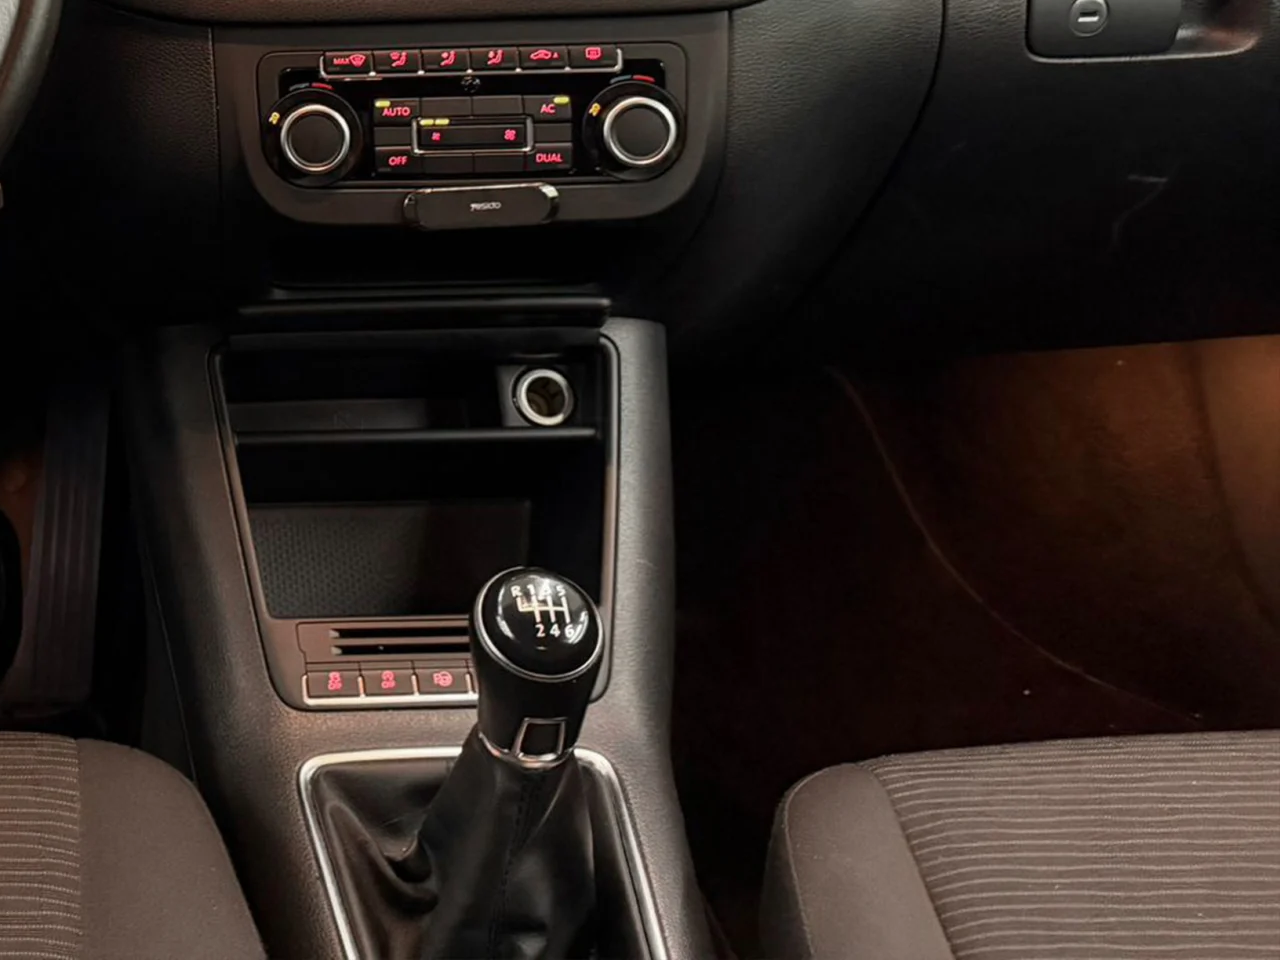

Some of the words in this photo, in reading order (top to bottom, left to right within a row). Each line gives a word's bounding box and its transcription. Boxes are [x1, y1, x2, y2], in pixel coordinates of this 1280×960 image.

[333, 56, 349, 65] MAX
[382, 106, 410, 117] AUTO
[540, 103, 556, 114] AC
[389, 155, 407, 166] OFF
[535, 152, 563, 163] DUAL
[510, 585, 522, 597] R
[527, 583, 536, 596] 1
[556, 584, 566, 597] 5
[535, 624, 546, 637] 2
[549, 623, 561, 638] 4
[564, 624, 575, 638] 6
